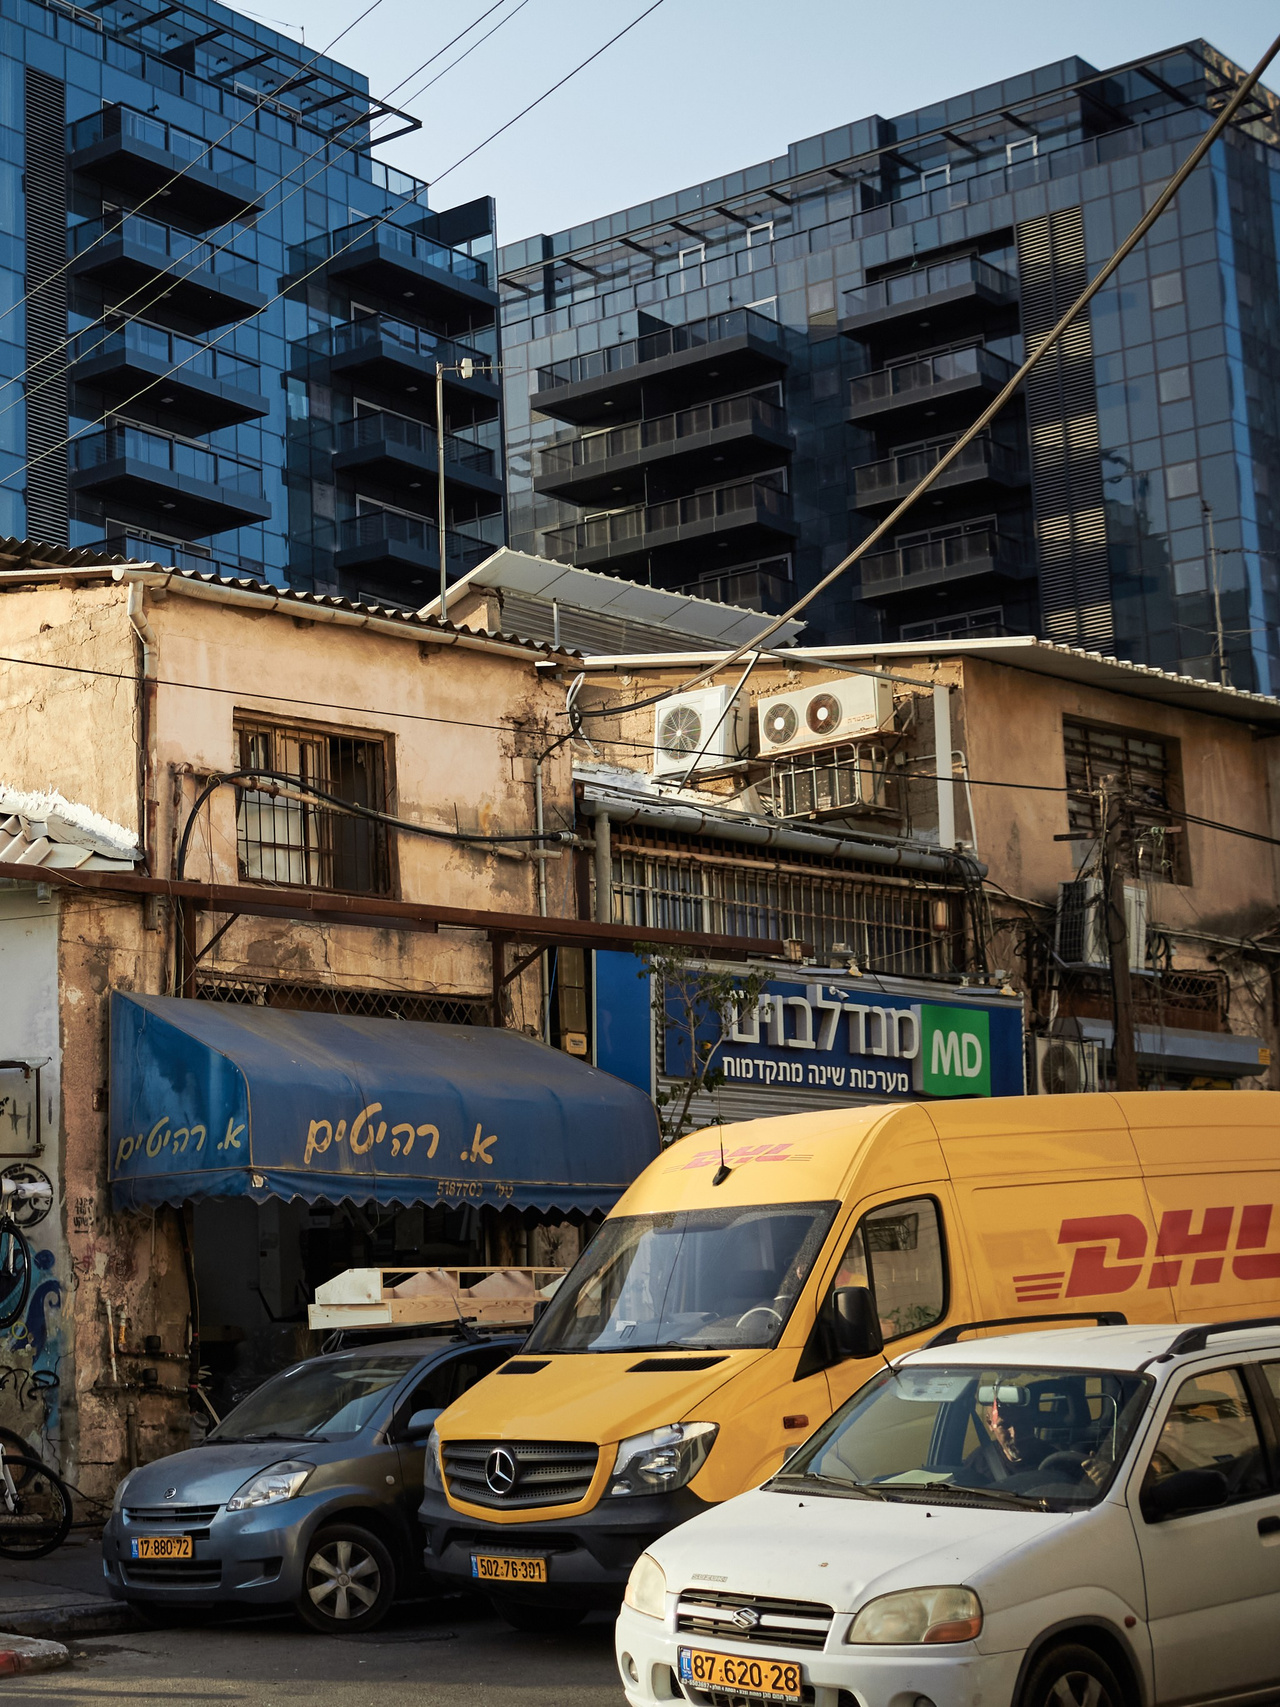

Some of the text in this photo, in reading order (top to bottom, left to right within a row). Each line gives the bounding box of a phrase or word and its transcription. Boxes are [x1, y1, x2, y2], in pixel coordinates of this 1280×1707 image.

[728, 984, 920, 1060] מנדלבוים
[722, 1056, 909, 1094] מערכות שינה מתקדמות
[930, 1029, 983, 1078] MD
[114, 1115, 207, 1171] רהיטים
[303, 1102, 498, 1165] א. רהיטים
[680, 1143, 794, 1171] DHL
[436, 1181, 483, 1198] 5187703
[1057, 1203, 1280, 1299] DHL
[691, 1573, 729, 1583] SUZUKI
